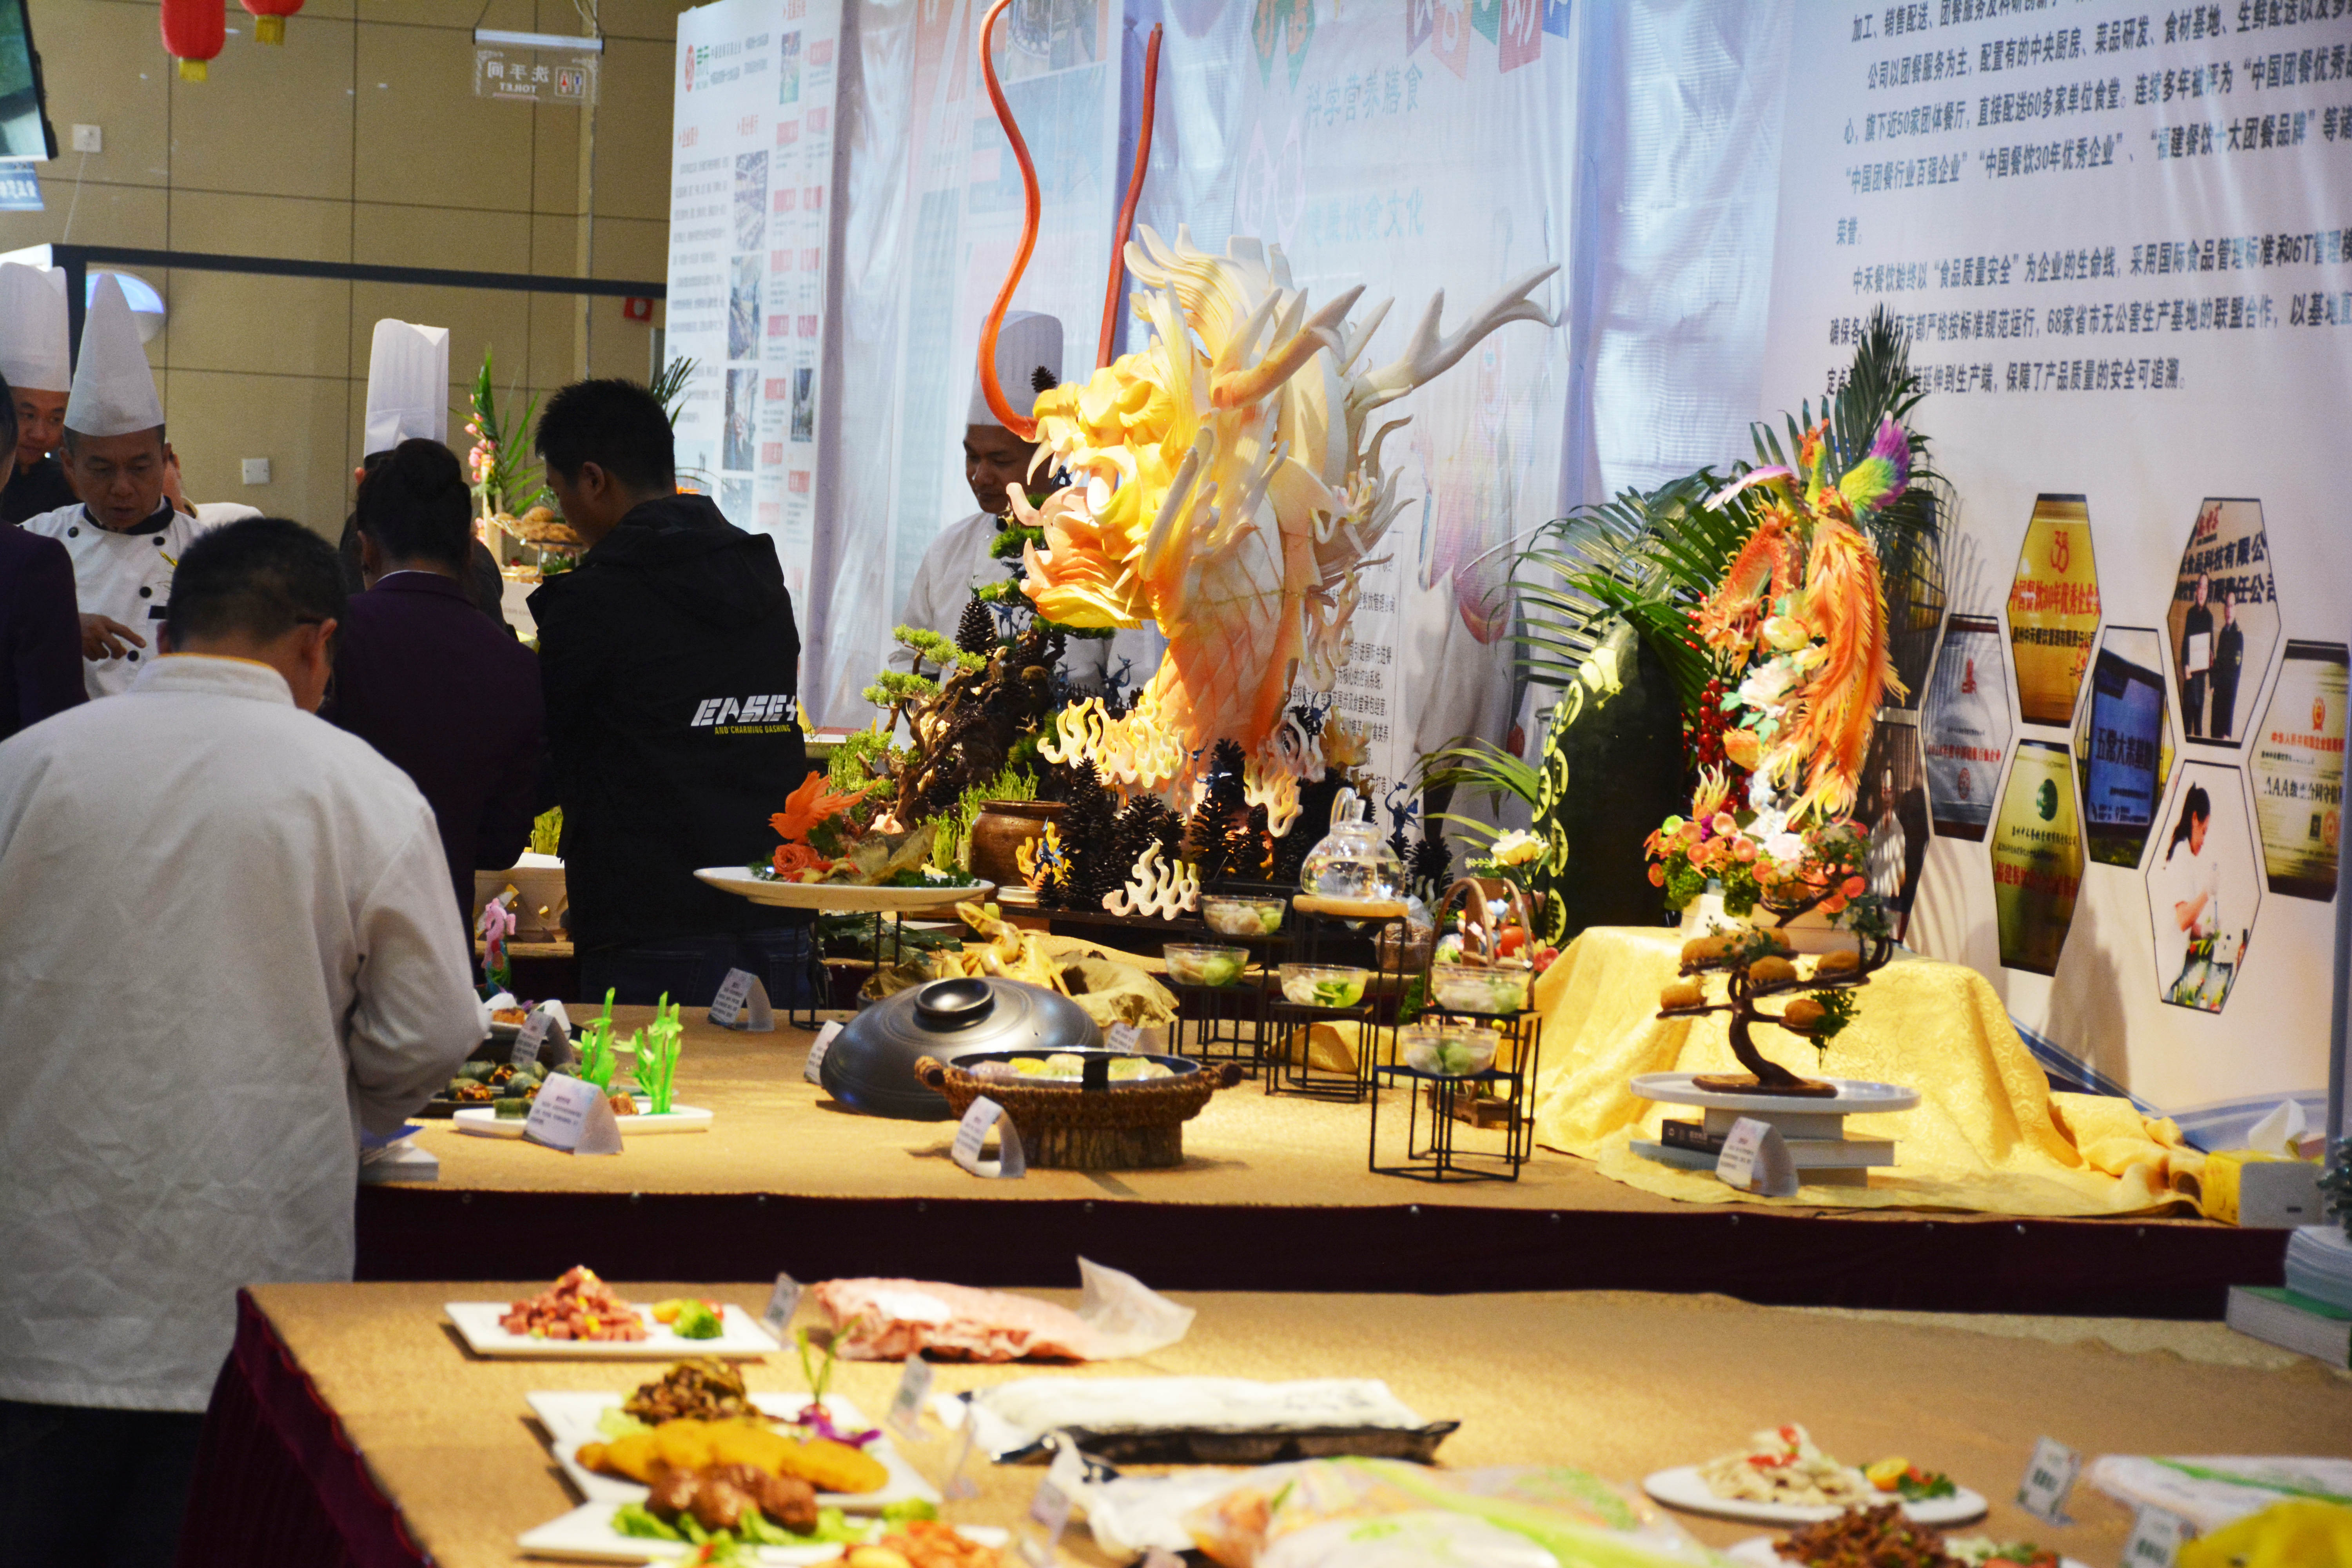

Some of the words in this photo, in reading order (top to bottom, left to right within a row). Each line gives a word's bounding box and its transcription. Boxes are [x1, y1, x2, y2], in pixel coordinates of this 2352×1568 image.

[1305, 61, 1423, 129] 科学营养膳食
[1307, 186, 1425, 247] 健康饮食文化
[731, 725, 763, 734] CHARMING
